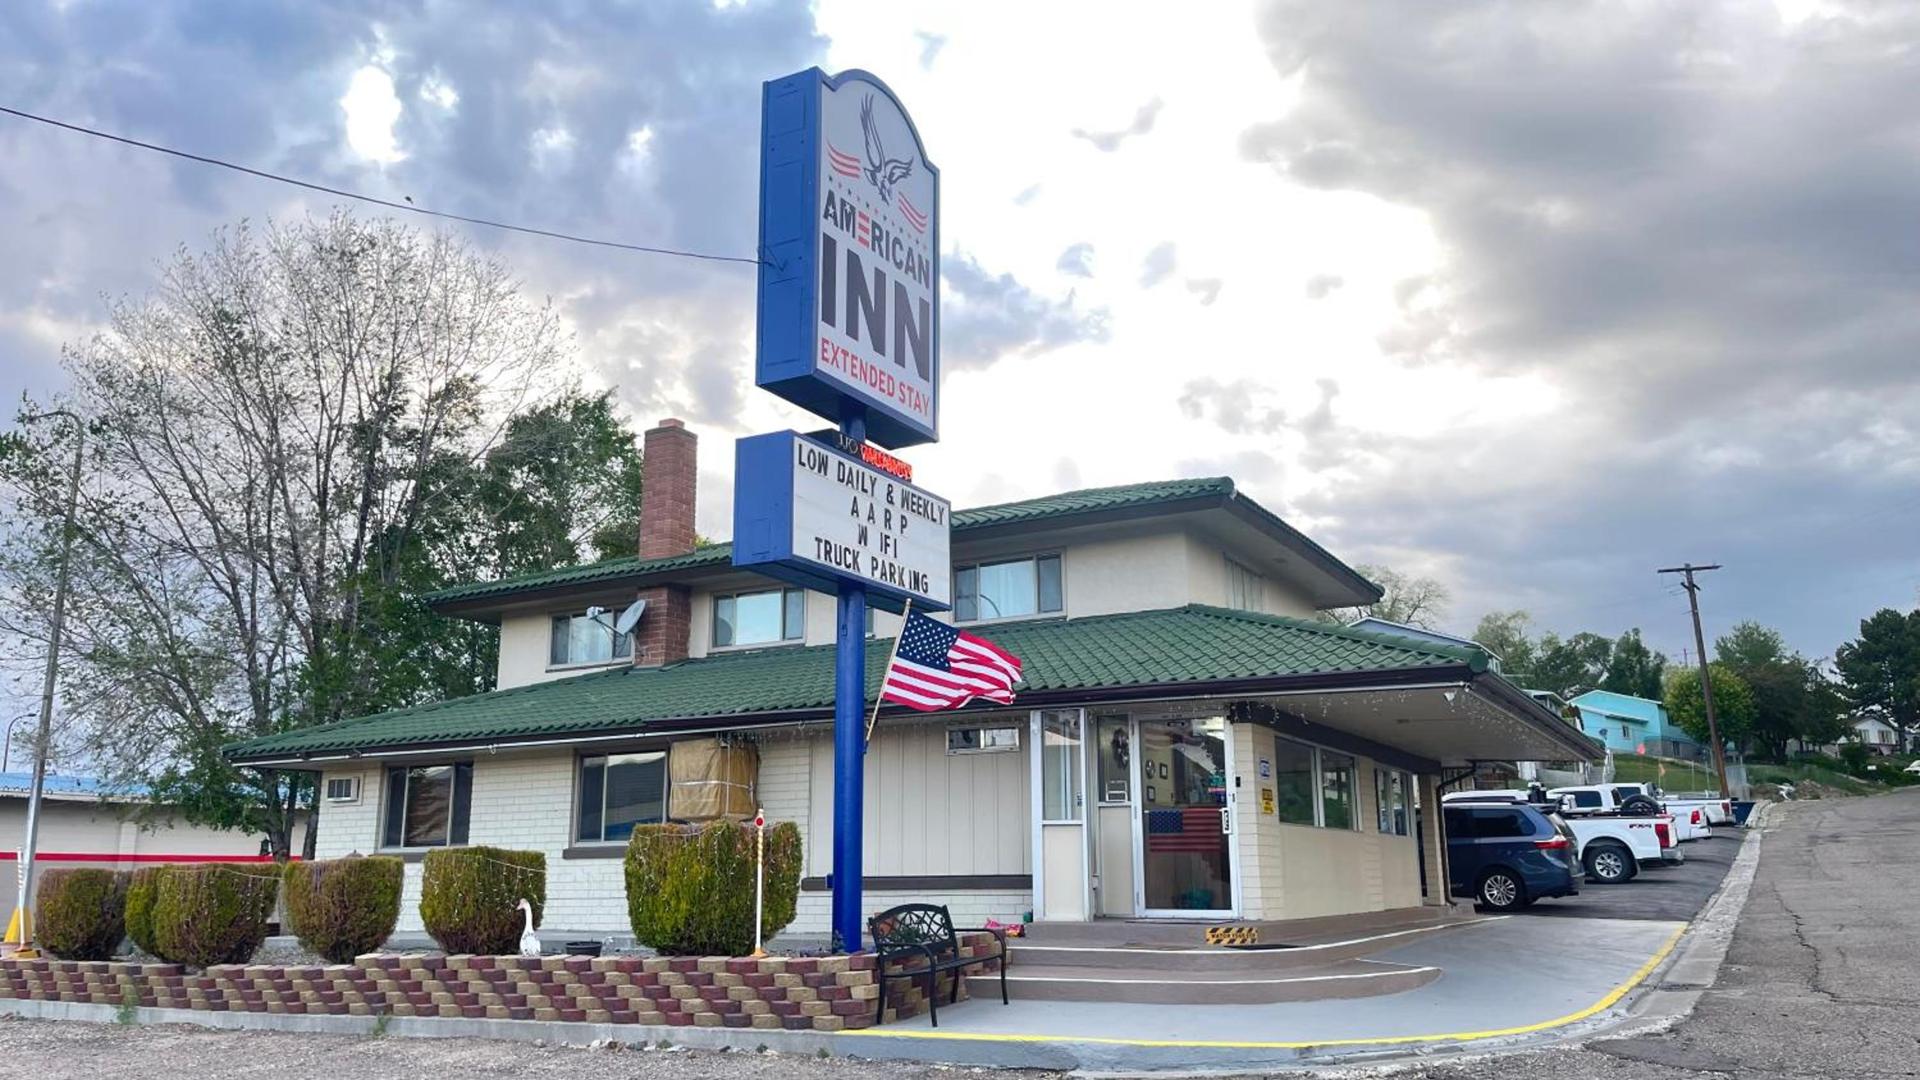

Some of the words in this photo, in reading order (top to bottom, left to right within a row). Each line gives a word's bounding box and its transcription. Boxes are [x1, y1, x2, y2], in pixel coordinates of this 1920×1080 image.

[822, 189, 930, 290] AMERICAN
[821, 231, 930, 383] INN
[821, 337, 895, 398] EXTENDED
[899, 382, 930, 417] STAY
[798, 444, 828, 476] LOW
[837, 460, 877, 497] DAILY
[886, 484, 895, 505] &
[901, 488, 944, 525] WEEKLY
[815, 537, 861, 572] TRUCK
[871, 556, 929, 594] PARKING
